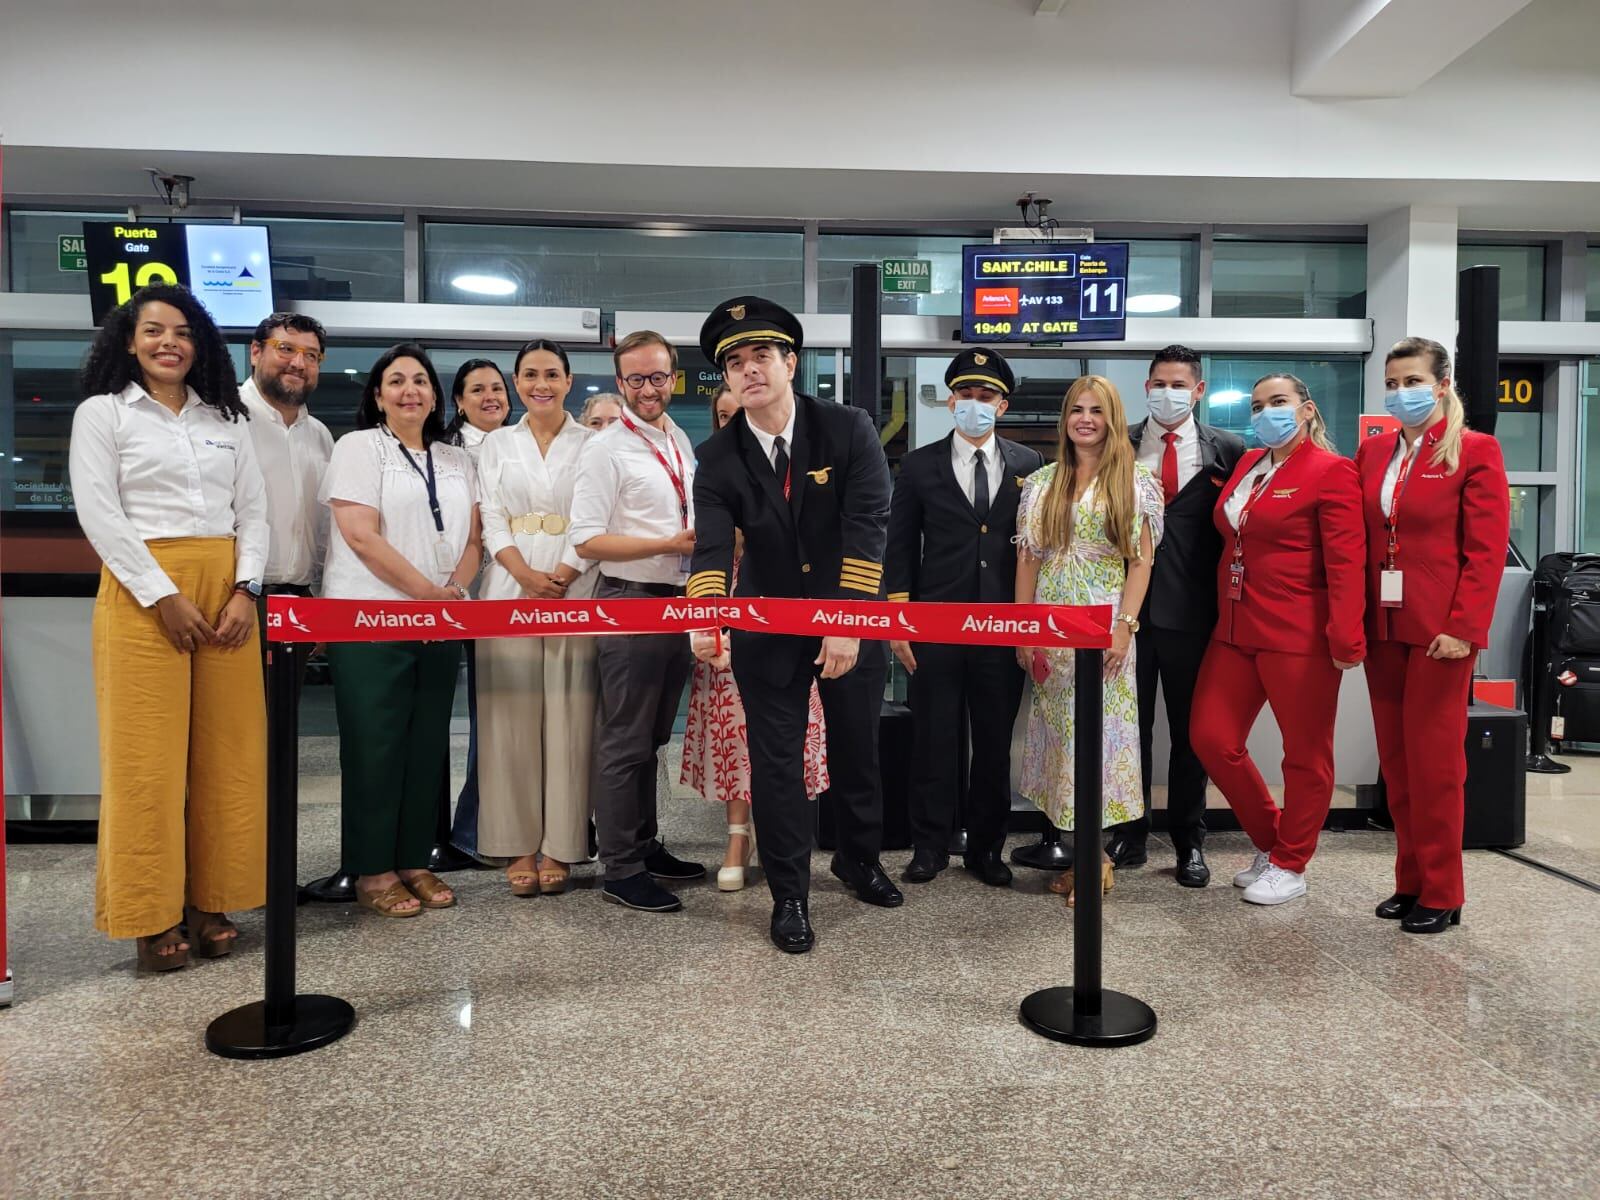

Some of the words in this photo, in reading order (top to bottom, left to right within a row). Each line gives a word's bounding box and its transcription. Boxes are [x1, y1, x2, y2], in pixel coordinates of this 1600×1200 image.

[114, 227, 157, 239] Puerta
[125, 243, 149, 253] Gate
[885, 262, 929, 276] SALIDA
[982, 261, 1068, 273] SANT.CHILE
[897, 280, 917, 290] EXIT
[1028, 296, 1043, 305] AV
[1044, 296, 1063, 304] 133
[1083, 283, 1118, 312] 11
[974, 322, 1011, 333] 19:40
[1021, 322, 1040, 333] AT
[1042, 322, 1078, 332] GATE
[699, 371, 722, 381] Gate
[1498, 379, 1533, 403] 10
[354, 610, 436, 628] Avianca
[509, 608, 590, 625] Avianca
[662, 603, 741, 621] Avianca
[811, 608, 891, 628] Avianca
[961, 614, 1040, 634] Avianca
